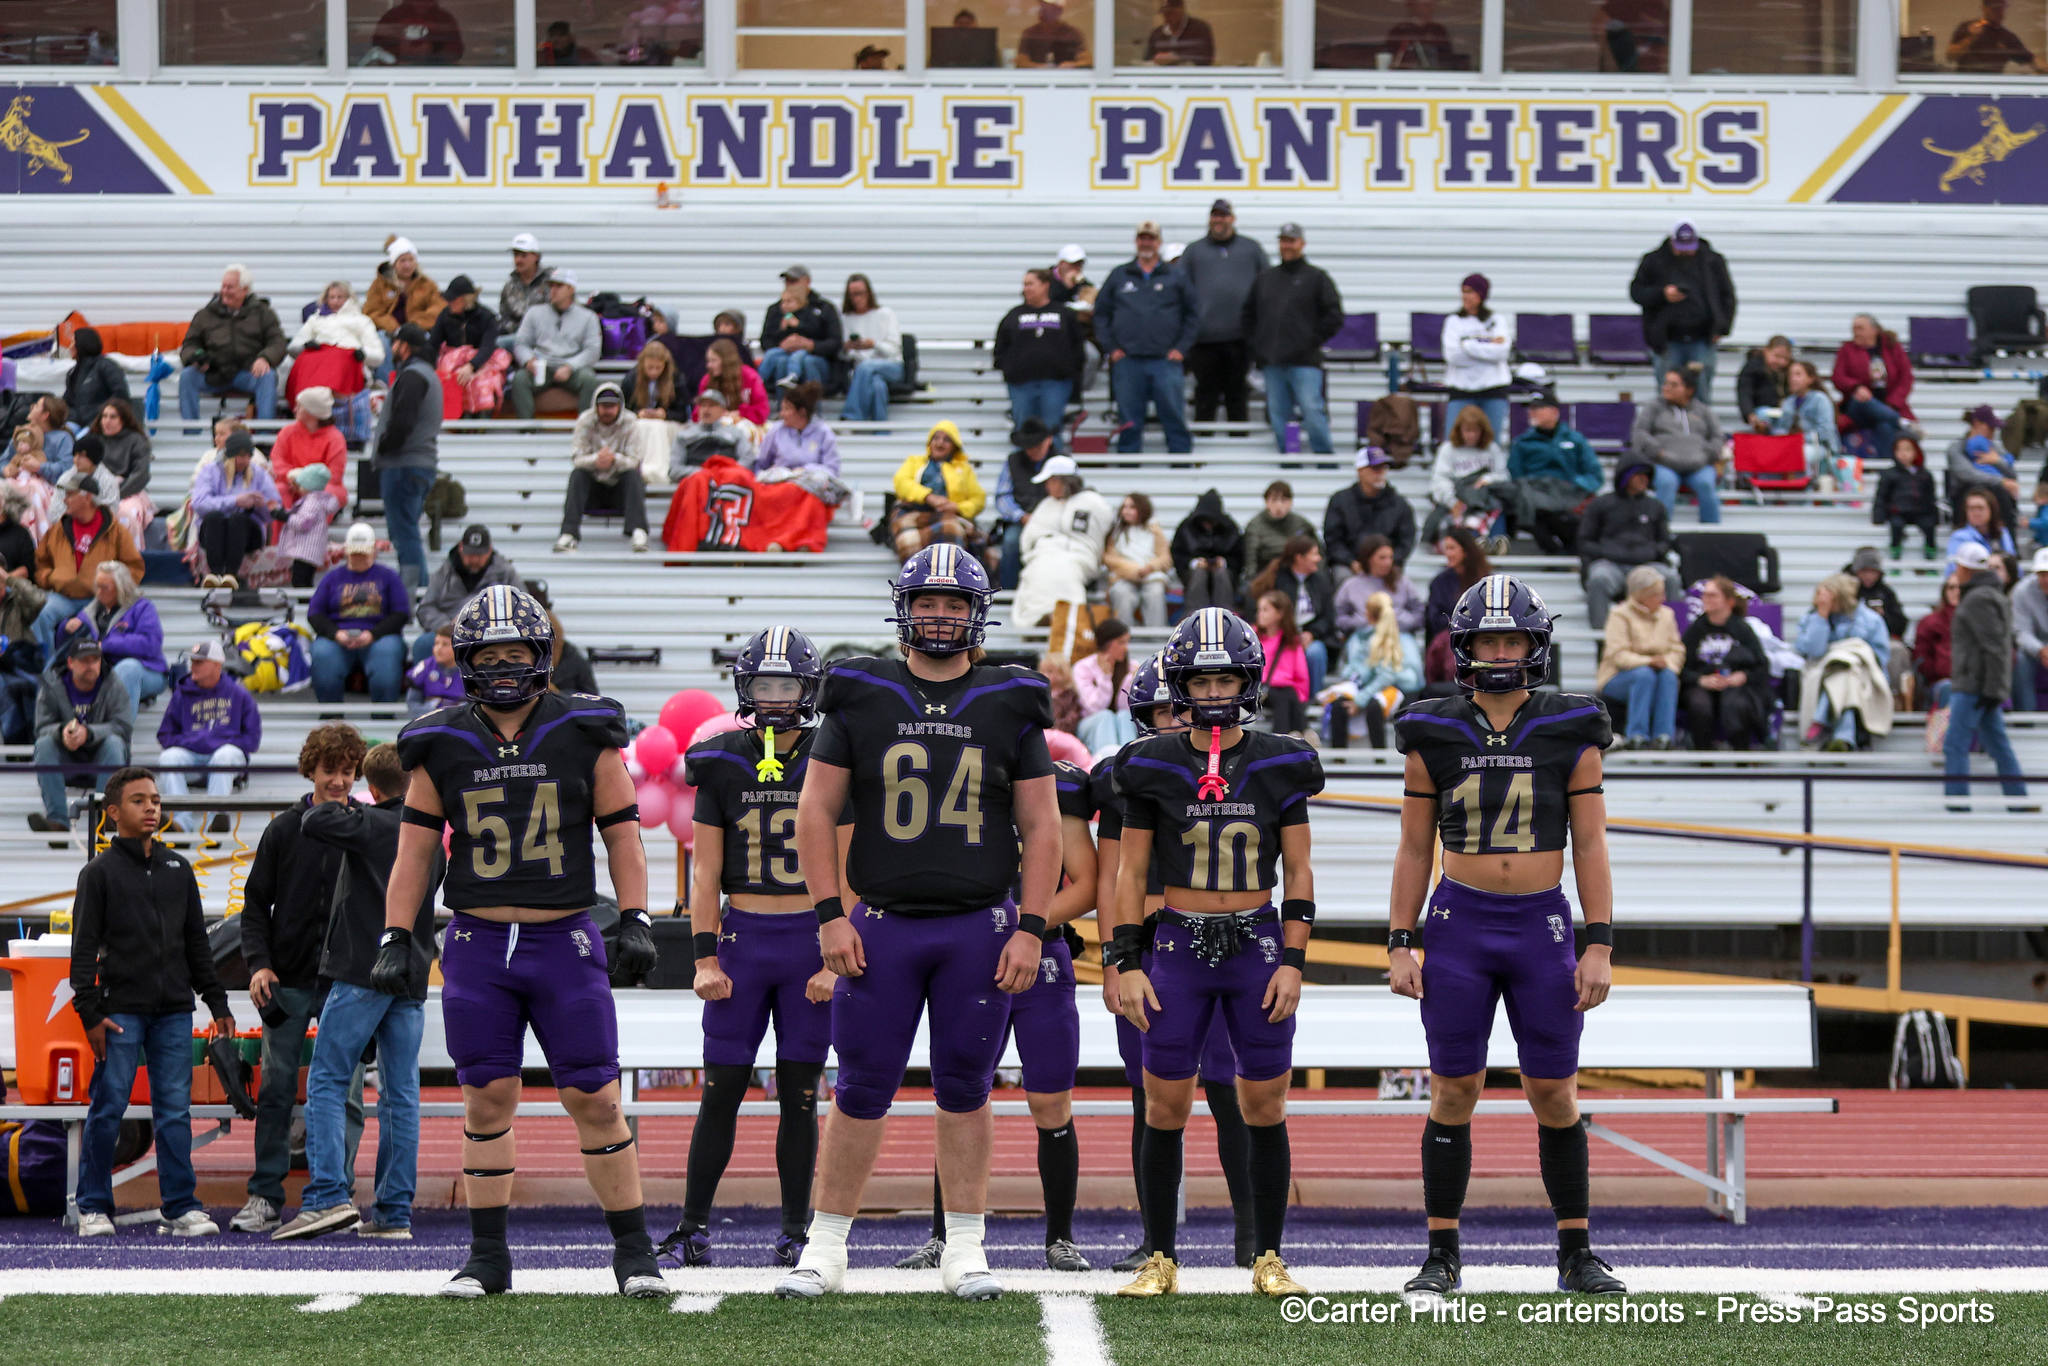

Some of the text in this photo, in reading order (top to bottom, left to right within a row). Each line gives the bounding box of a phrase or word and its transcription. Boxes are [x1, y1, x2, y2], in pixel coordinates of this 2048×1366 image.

[253, 98, 1763, 189] PANHANDLE PANTHERS
[898, 722, 972, 738] PANTHERS
[1461, 755, 1533, 769] PANTHERS
[473, 764, 547, 782] PANTHERS
[882, 740, 986, 846] 64
[1186, 803, 1256, 817] PANTHERS
[461, 779, 567, 881] 54
[736, 808, 806, 887] 13
[1452, 771, 1537, 854] 14
[1180, 819, 1262, 892] 10
